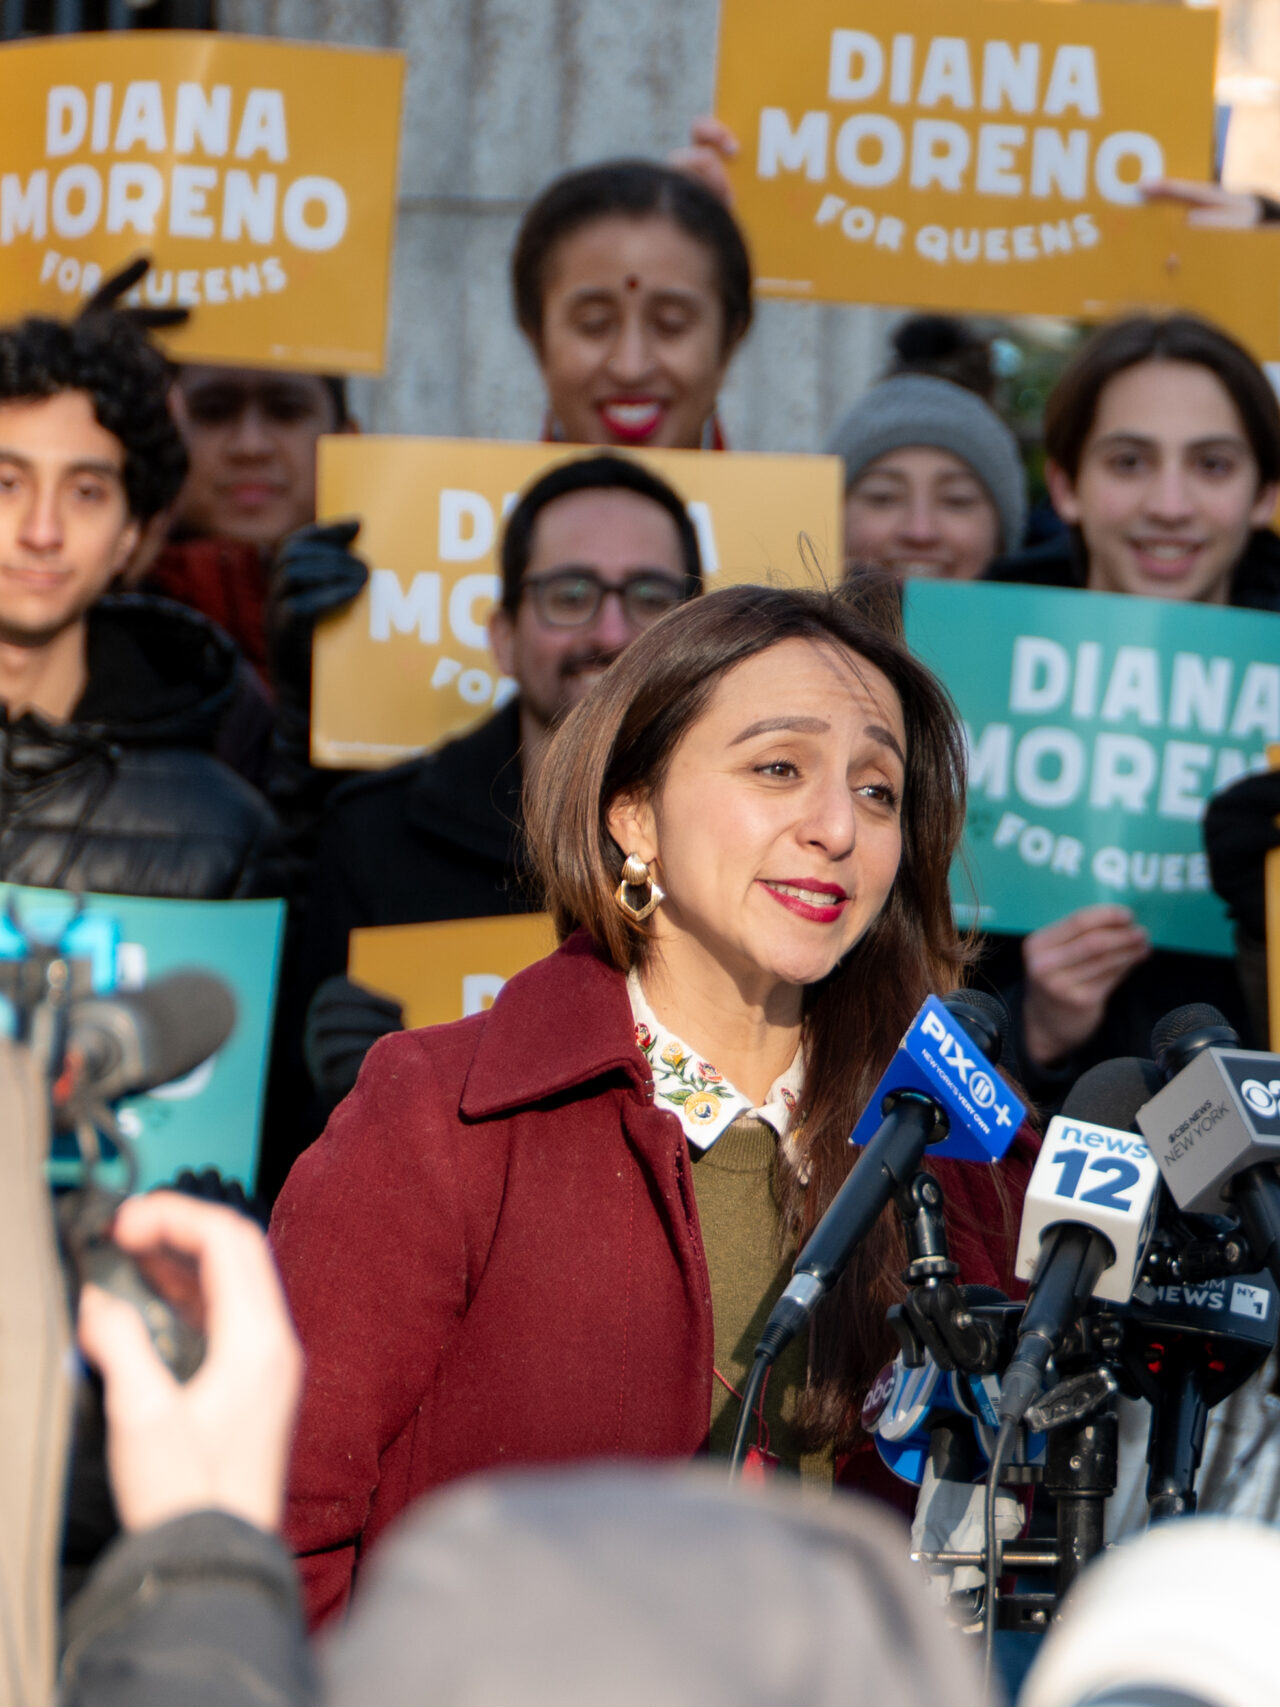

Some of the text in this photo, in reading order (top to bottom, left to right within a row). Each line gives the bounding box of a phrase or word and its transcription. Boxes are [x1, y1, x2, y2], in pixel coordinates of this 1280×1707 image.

[828, 27, 1102, 119] DIANA
[45, 81, 289, 163] DIANA
[756, 107, 1165, 206] MORENO
[0, 162, 349, 252] MORENO
[814, 193, 1100, 264] FOR QUEENS
[122, 257, 288, 307] UEENS
[993, 811, 1084, 878] FOR
[921, 1048, 937, 1069] NEW
[957, 1092, 975, 1116] VERY
[972, 1112, 991, 1135] OWN
[1173, 1099, 1213, 1139] CBS NEWS
[1060, 1125, 1149, 1160] news
[1164, 1101, 1231, 1168] NEW YORK
[1052, 1148, 1141, 1213] 12
[1236, 1285, 1257, 1298] NY
[1252, 1301, 1264, 1316] 1
[861, 1374, 896, 1412] abc
